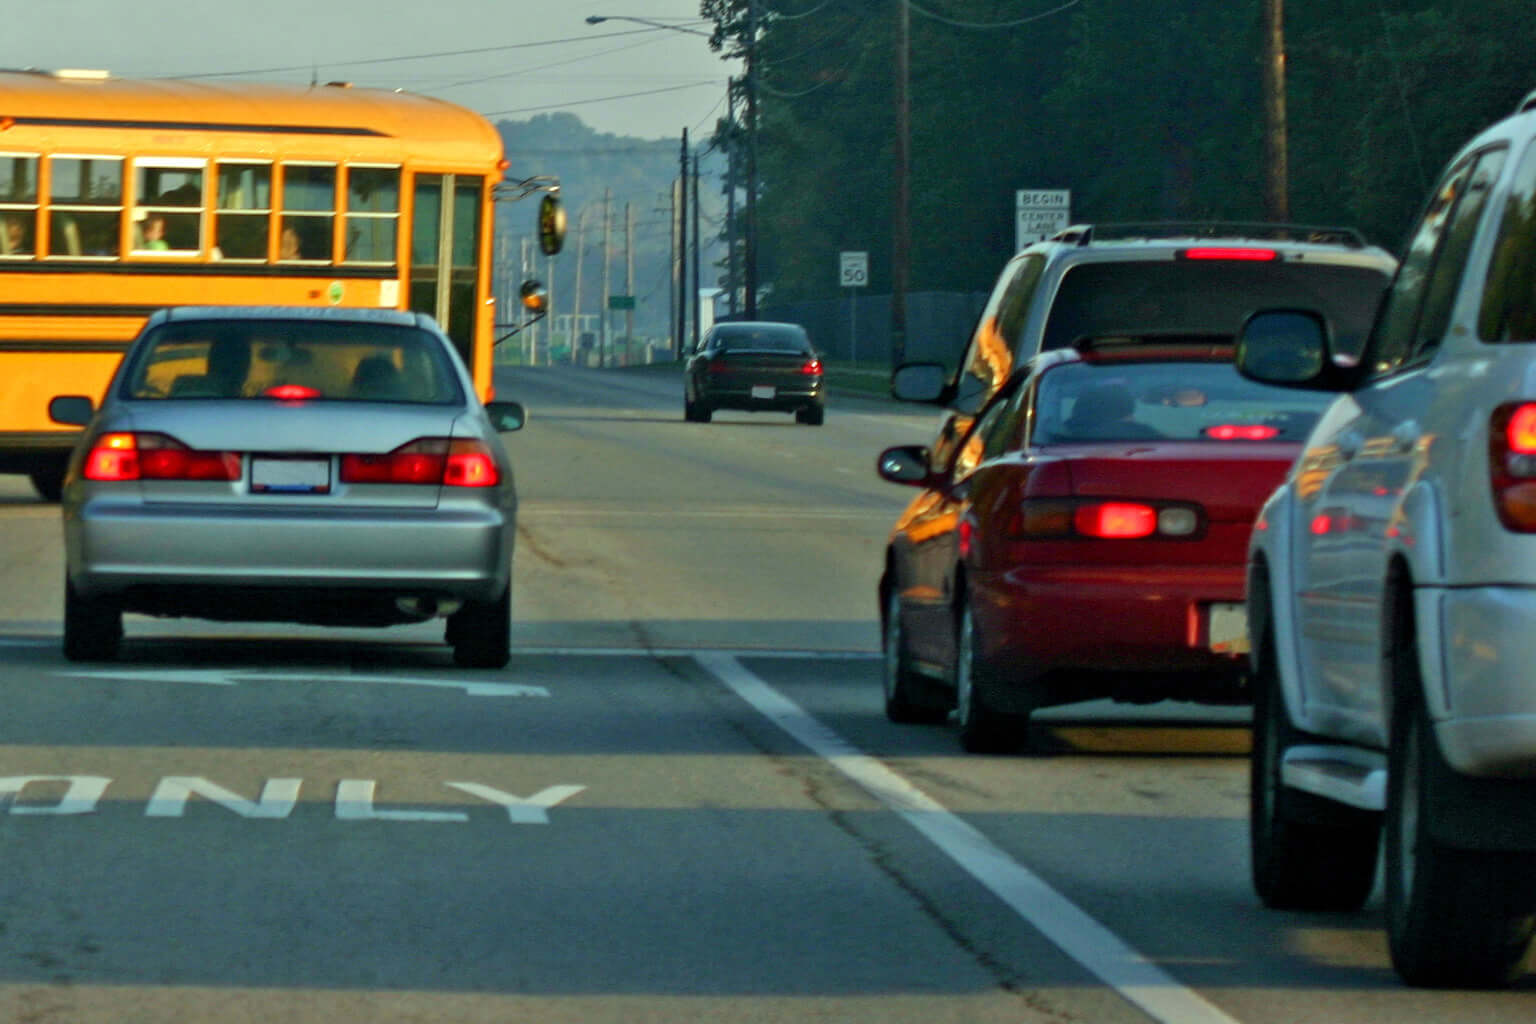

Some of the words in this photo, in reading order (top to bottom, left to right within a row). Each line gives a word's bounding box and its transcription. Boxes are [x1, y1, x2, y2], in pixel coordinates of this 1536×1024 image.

[1022, 193, 1064, 206] BEGIN
[1021, 211, 1065, 222] CENTER
[843, 269, 866, 282] 50
